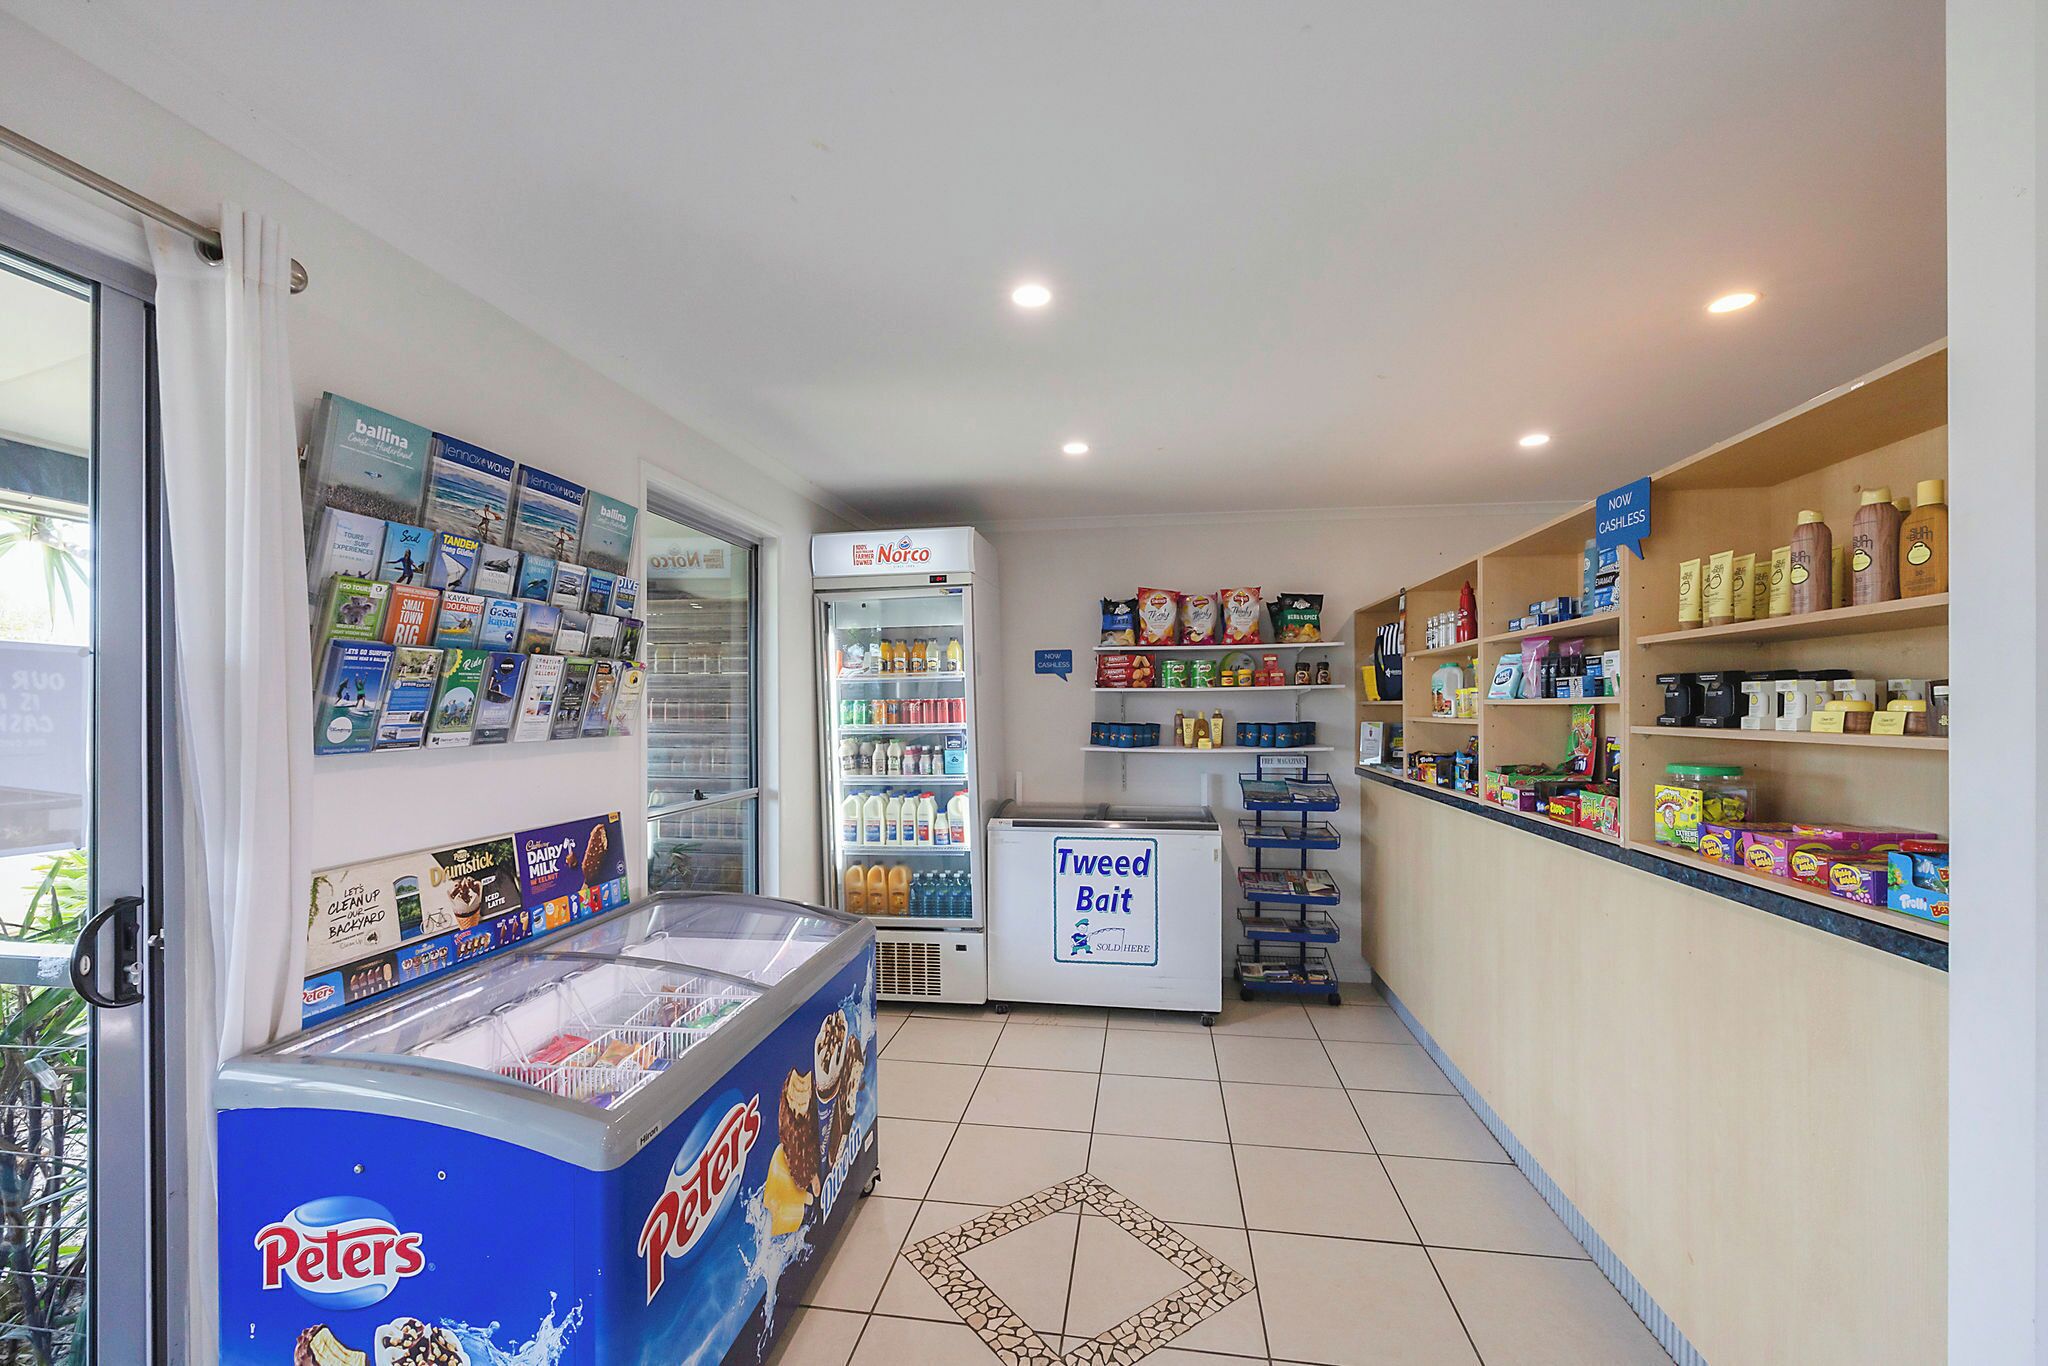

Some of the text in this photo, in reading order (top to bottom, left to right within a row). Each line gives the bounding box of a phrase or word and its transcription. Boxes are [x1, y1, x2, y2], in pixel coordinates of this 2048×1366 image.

[356, 418, 408, 450] ballina
[445, 442, 511, 477] lennox wave
[562, 484, 585, 502] wave
[1608, 492, 1632, 511] NOW
[600, 504, 627, 524] ballina
[1598, 510, 1646, 534] CASHLESS
[344, 531, 364, 541] TOURS
[400, 530, 421, 544] Soul
[443, 534, 479, 550] TANDEM
[878, 544, 930, 563] Norco
[402, 598, 425, 612] SMALL
[448, 593, 470, 602] KAYAK
[400, 610, 424, 624] TOWN
[446, 602, 480, 614] DOLPHINS
[394, 624, 420, 645] BIG
[463, 656, 482, 670] Ride
[527, 844, 562, 864] DAIRY
[1058, 848, 1151, 877] Tweed
[430, 851, 495, 888] Drumstick
[529, 860, 560, 878] MILK
[344, 884, 365, 898] LET'S
[485, 892, 500, 902] ICED
[1076, 885, 1133, 913] Bait
[328, 889, 380, 915] CLEAN UP
[488, 897, 506, 908] LATTE
[1900, 894, 1927, 911] Trolli
[347, 908, 365, 918] OUR
[328, 910, 385, 939] BACKYARD
[1096, 944, 1150, 953] SOLD HERE
[302, 986, 335, 1002] Peters
[640, 1124, 659, 1146] Hiron
[640, 1094, 760, 1302] Peters
[257, 1226, 424, 1287] Peters
